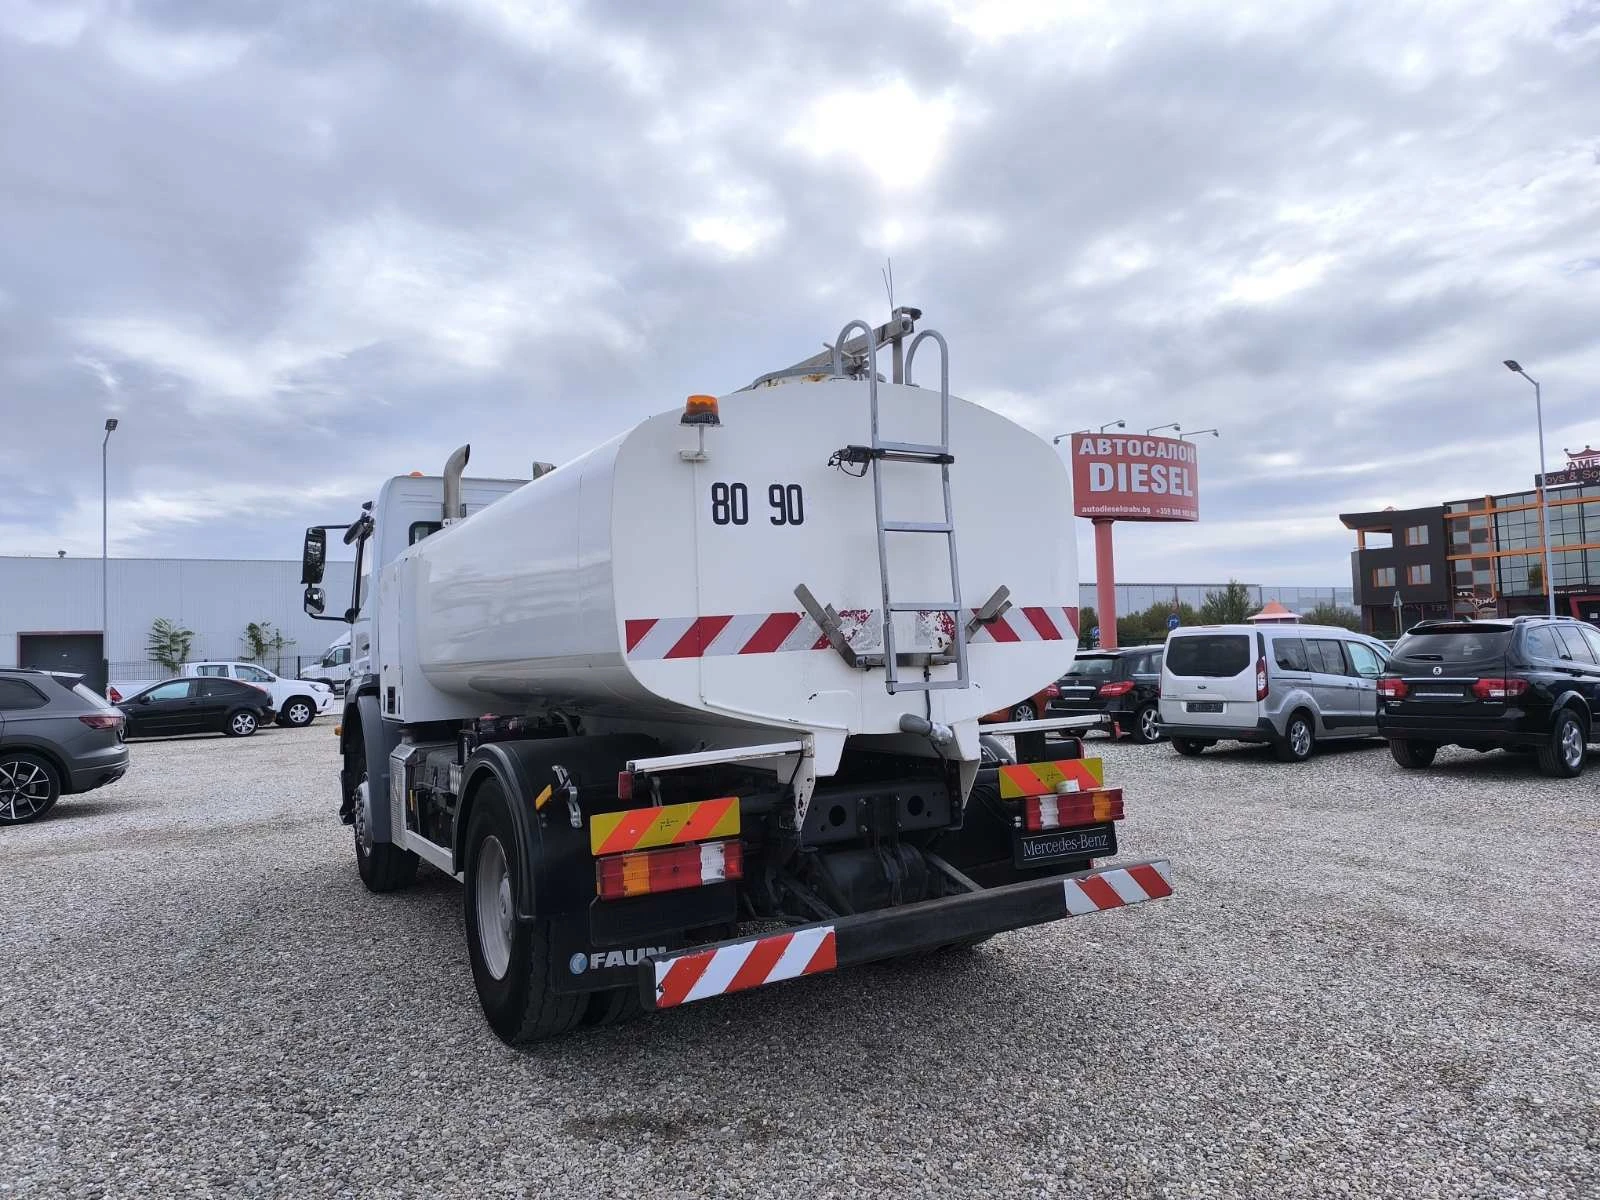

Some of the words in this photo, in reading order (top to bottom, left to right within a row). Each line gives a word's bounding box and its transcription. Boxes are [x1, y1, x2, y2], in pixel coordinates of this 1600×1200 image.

[1079, 438, 1196, 464] АВТОСАЛОН
[1089, 462, 1193, 497] DIESEL
[711, 482, 749, 525] 80
[768, 483, 804, 526] 90
[1023, 834, 1109, 857] Mercedes-Benz
